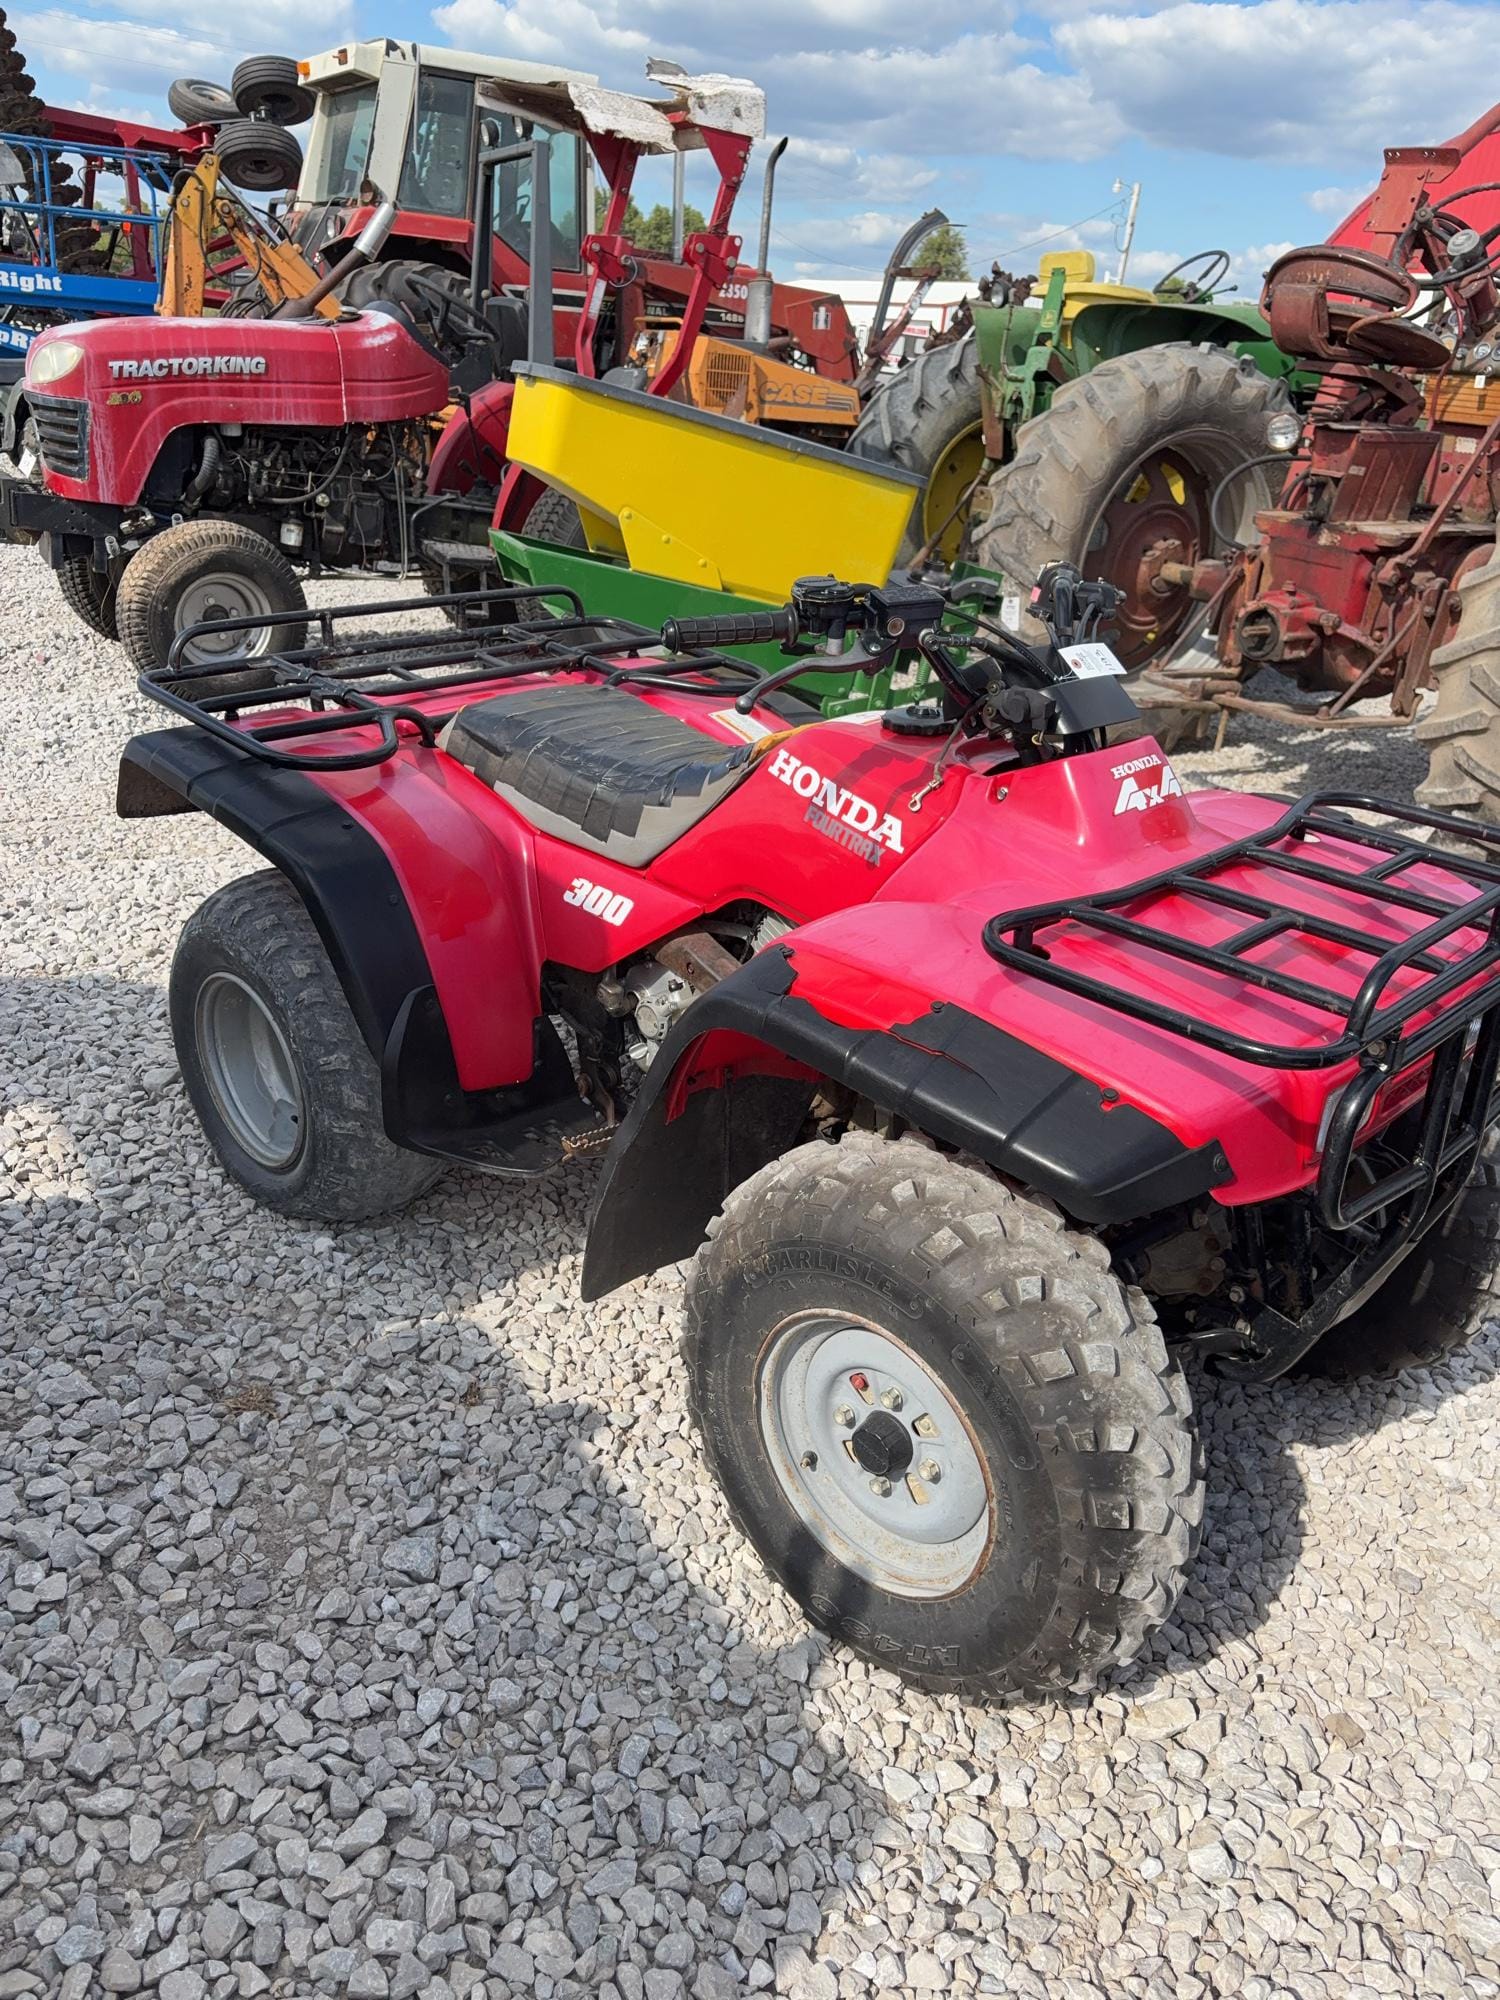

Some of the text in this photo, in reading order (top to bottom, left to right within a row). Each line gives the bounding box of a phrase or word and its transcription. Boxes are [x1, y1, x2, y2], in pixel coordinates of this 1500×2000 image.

[108, 355, 266, 378] TRACTORKING
[759, 380, 831, 405] CASE
[1110, 754, 1162, 779] HONDA
[768, 749, 904, 854] HONDA
[804, 804, 886, 867] FOURTRAX
[563, 877, 634, 927] 300
[766, 1249, 900, 1299] CARLISLE
